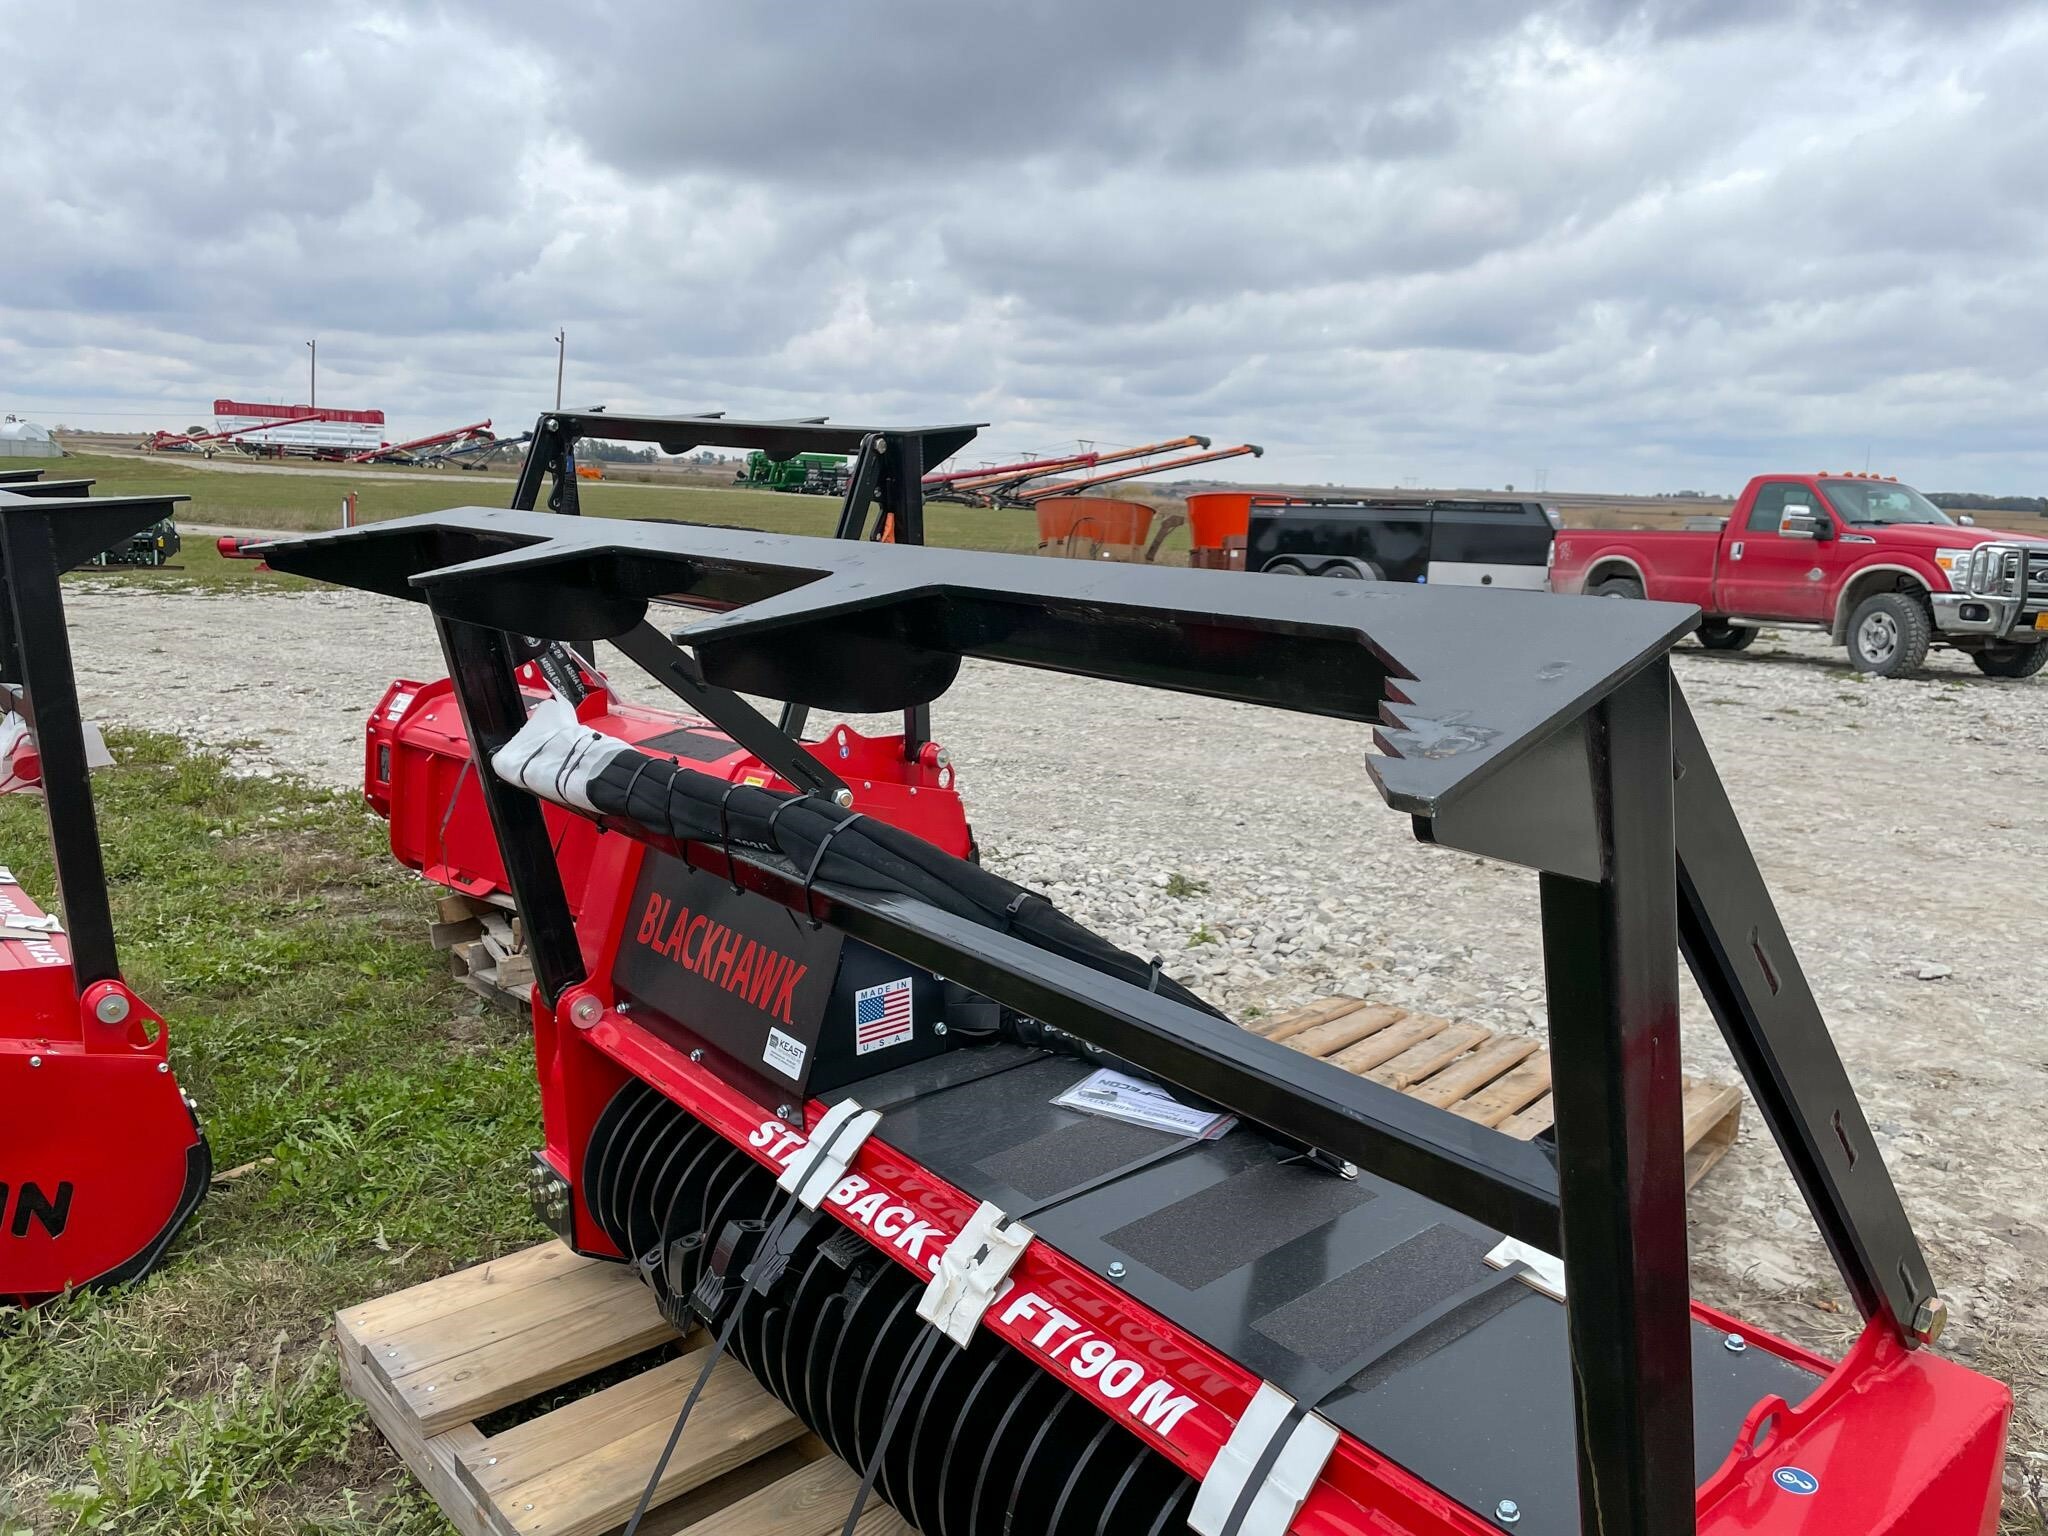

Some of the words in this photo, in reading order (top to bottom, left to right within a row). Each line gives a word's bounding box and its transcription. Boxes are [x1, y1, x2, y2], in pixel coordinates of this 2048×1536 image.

[636, 891, 808, 1024] BLACKHAWK
[860, 985, 891, 1000] MADE
[896, 981, 907, 990] IN
[779, 1039, 804, 1059] KEAST
[827, 1174, 947, 1261] BACK
[1000, 1292, 1145, 1398] FT/90
[1128, 1379, 1199, 1437] M
